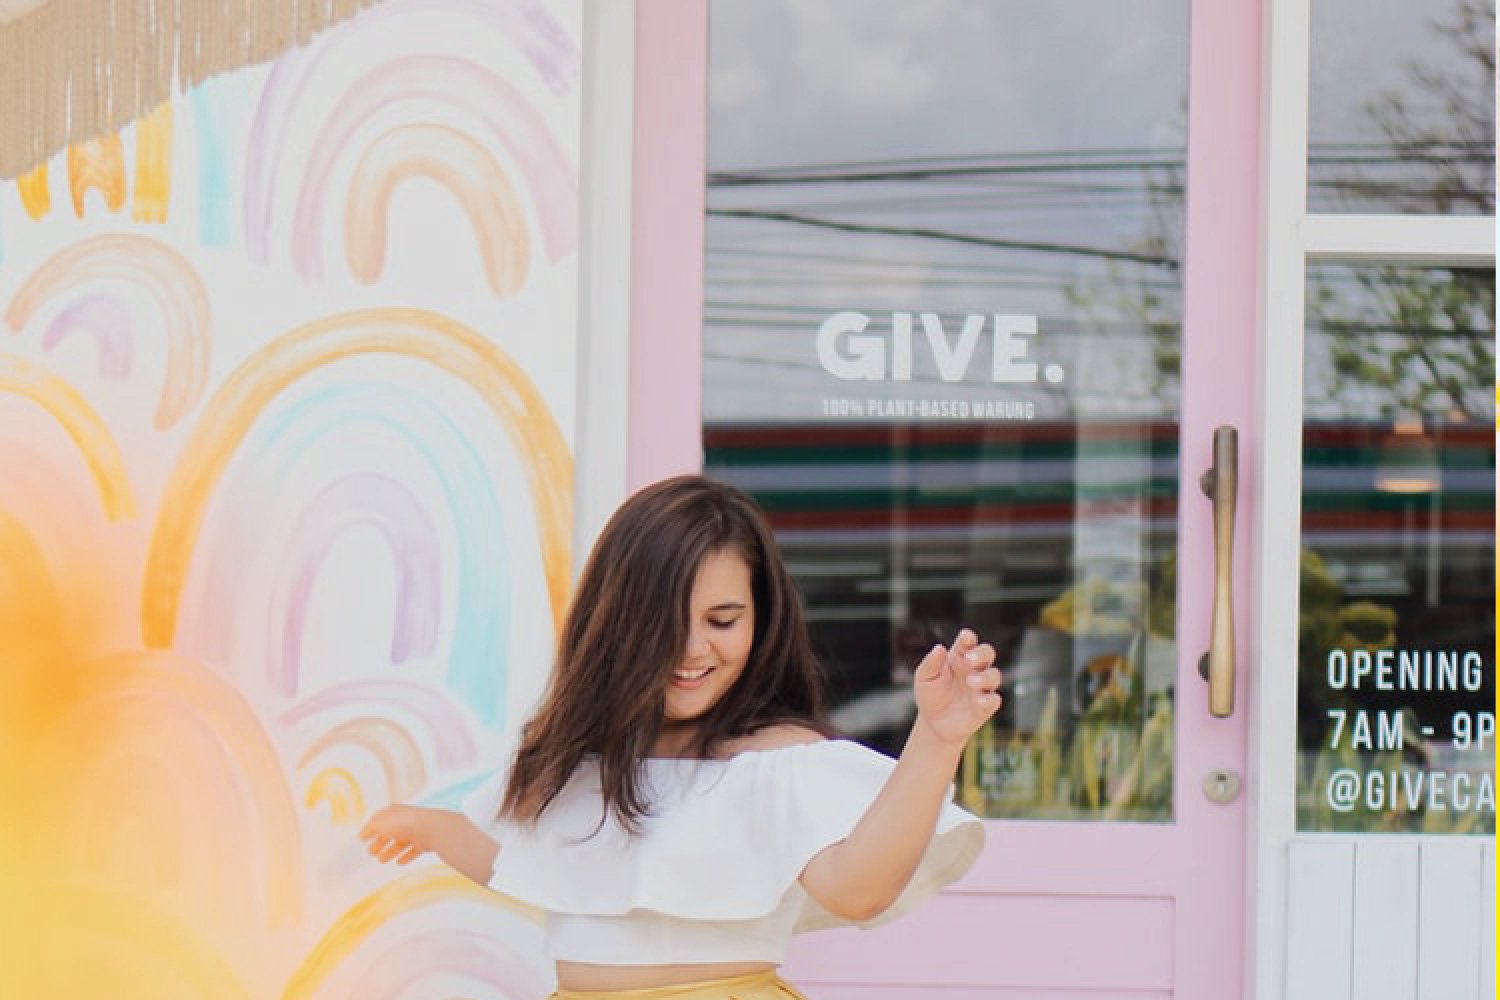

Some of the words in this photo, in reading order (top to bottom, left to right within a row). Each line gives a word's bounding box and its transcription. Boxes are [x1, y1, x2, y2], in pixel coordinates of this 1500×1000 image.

[816, 311, 1065, 383] GIVE.
[867, 400, 969, 418] PLANT-BASED
[972, 401, 1035, 420] WARUNG
[1327, 649, 1482, 691] OPENING
[1327, 710, 1404, 749] 7AM
[1327, 769, 1496, 813] @GIVECA
